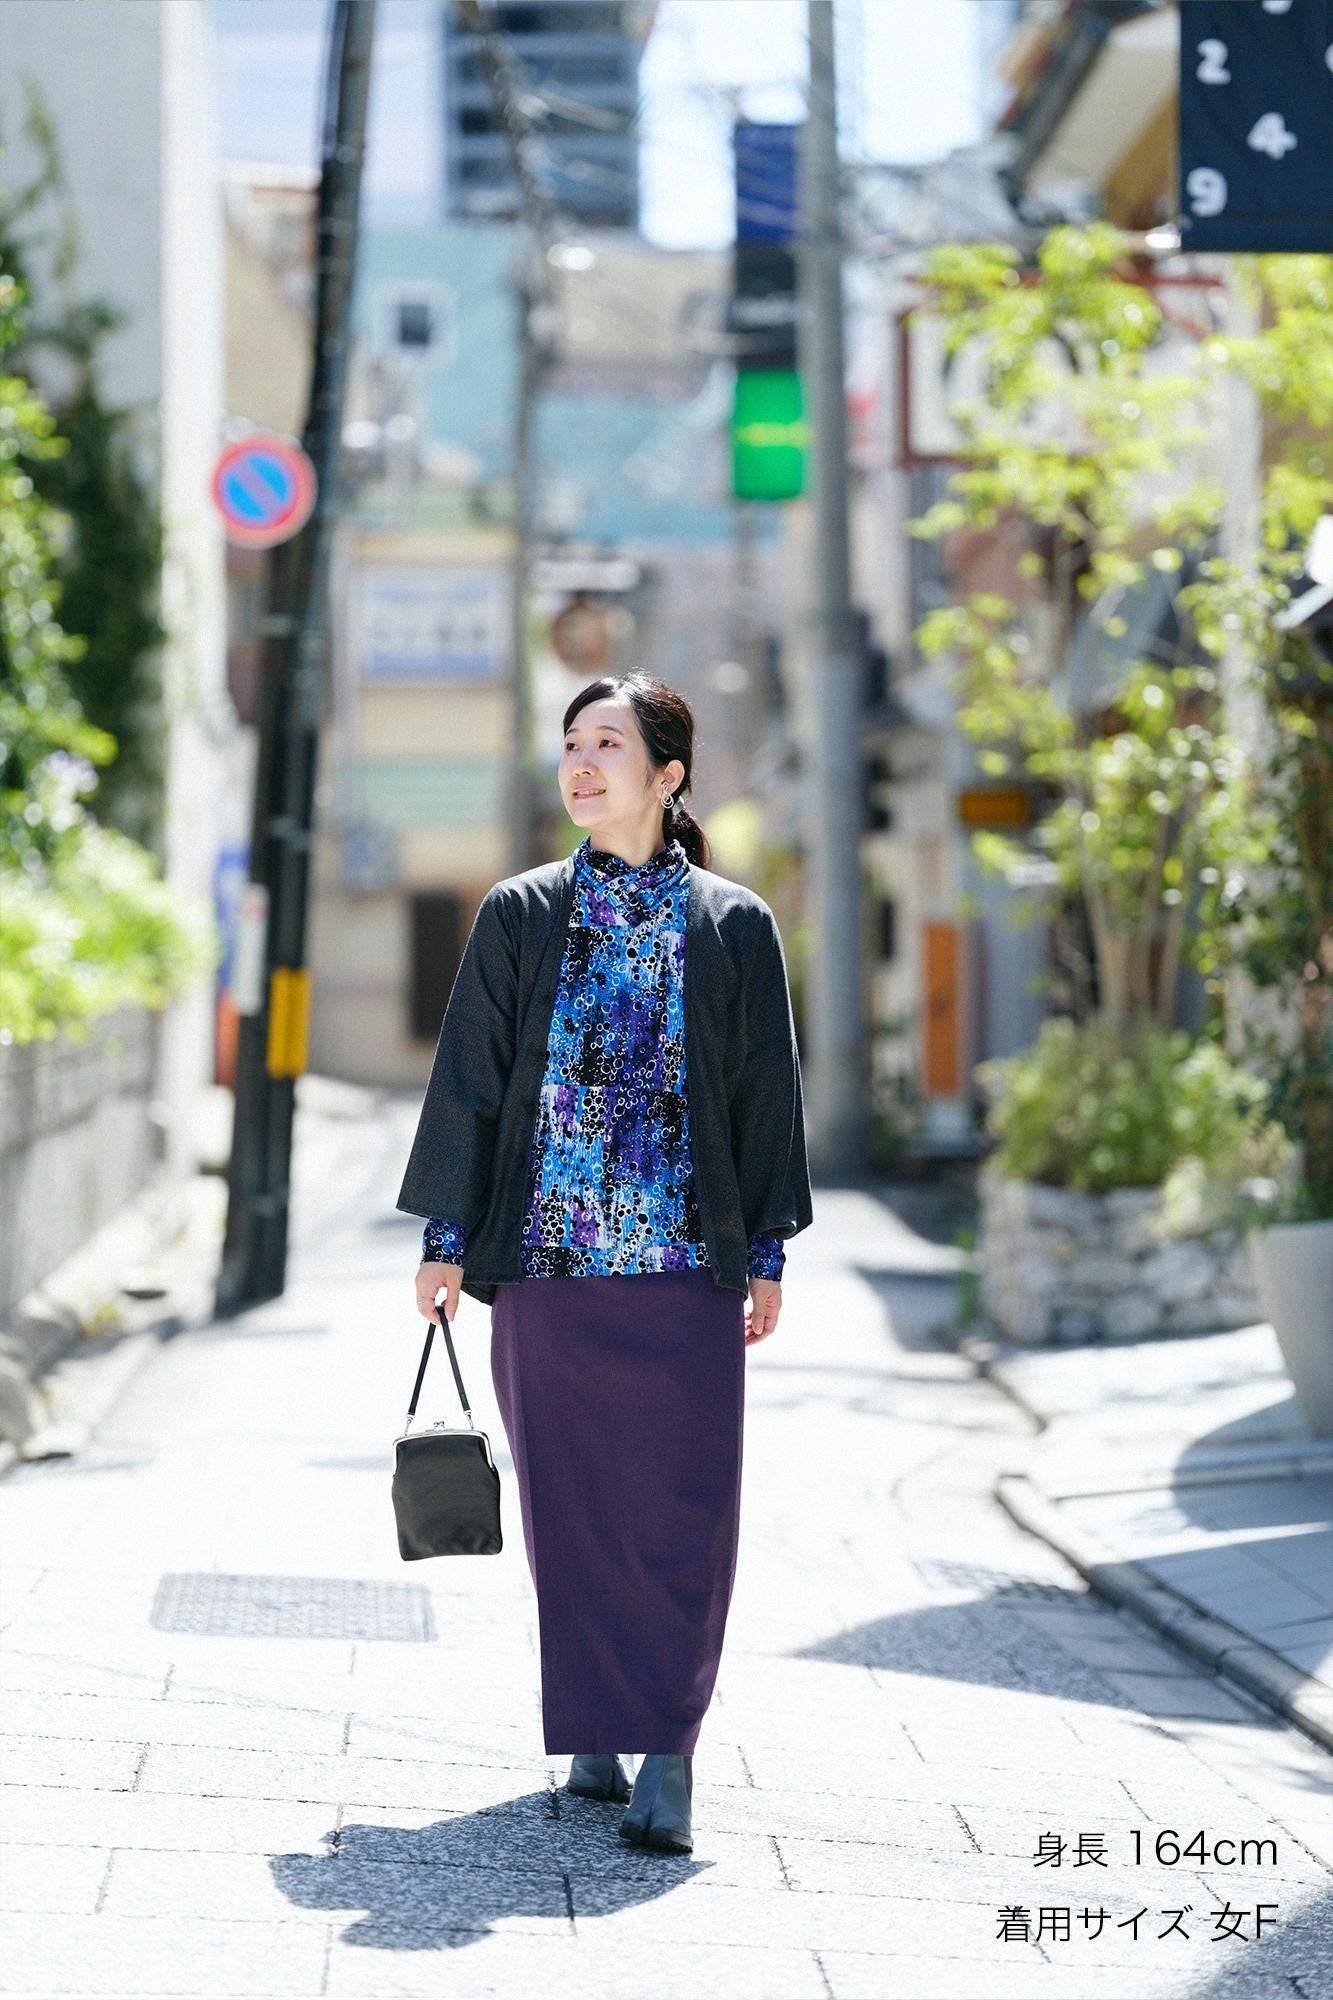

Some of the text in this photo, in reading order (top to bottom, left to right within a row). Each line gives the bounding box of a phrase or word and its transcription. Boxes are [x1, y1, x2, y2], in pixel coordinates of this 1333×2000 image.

[1197, 39, 1231, 85] 2
[1247, 112, 1298, 160] 4
[1186, 166, 1228, 217] 9
